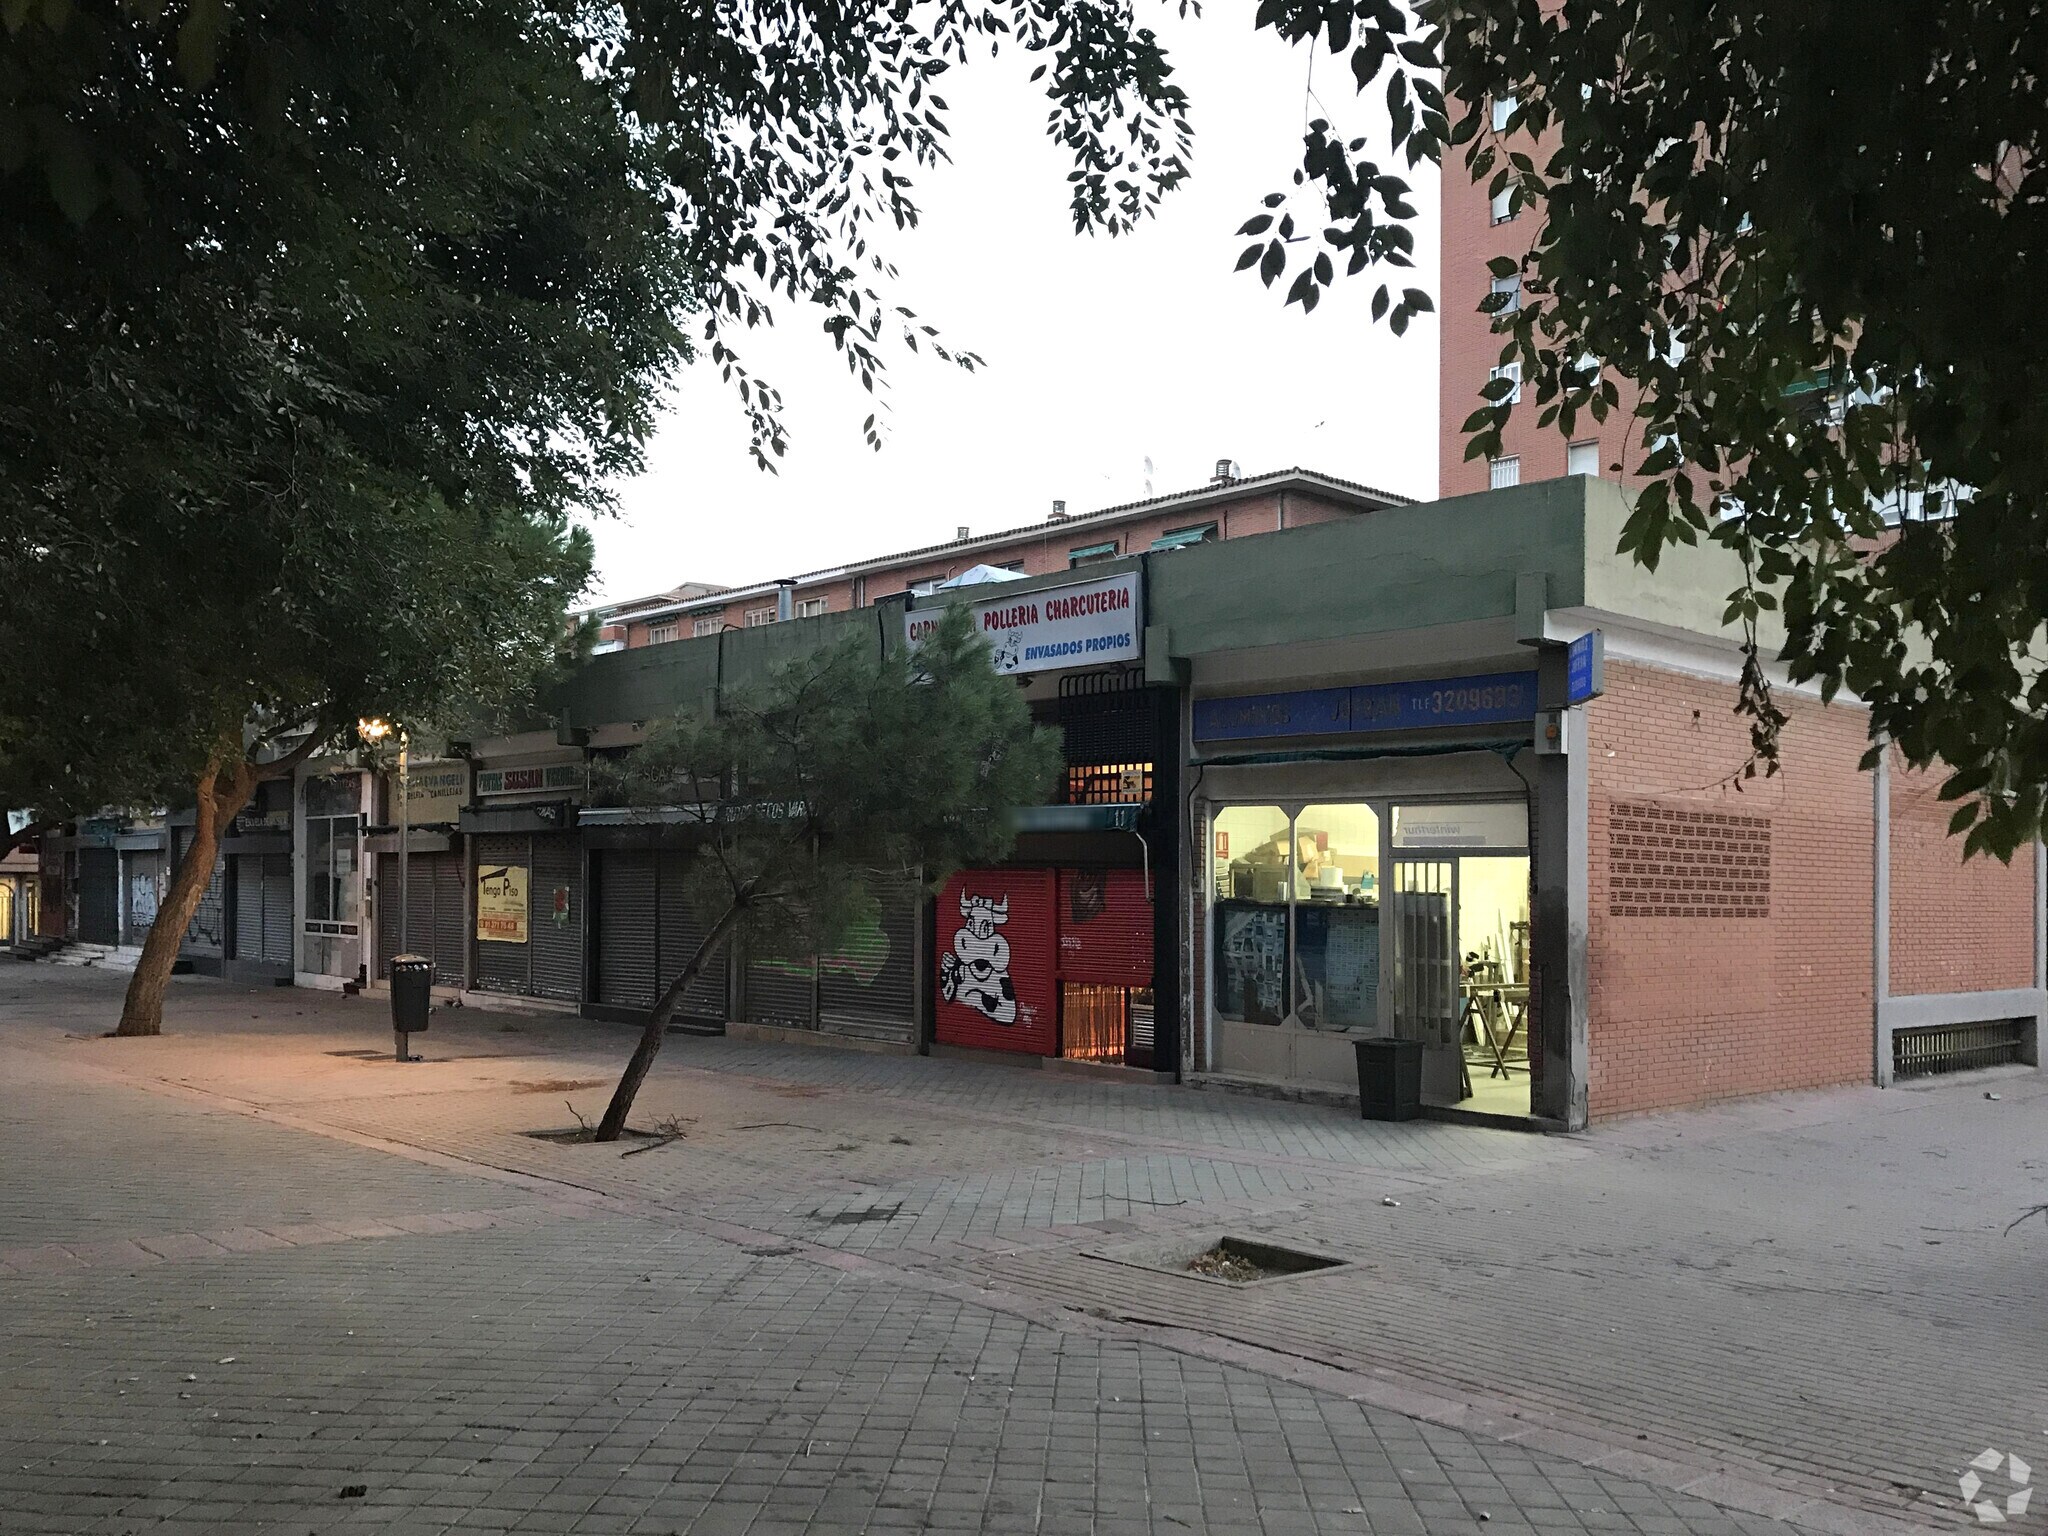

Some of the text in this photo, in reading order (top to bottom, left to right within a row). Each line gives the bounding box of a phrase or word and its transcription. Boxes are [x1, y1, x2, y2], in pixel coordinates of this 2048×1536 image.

[983, 603, 1039, 632] POLLERIA
[1045, 586, 1131, 622] CHARCUTERIA
[1024, 632, 1132, 661] ENVASADOS PROPIOS
[1410, 698, 1430, 713] TLF
[481, 877, 519, 898] Tengo Piso
